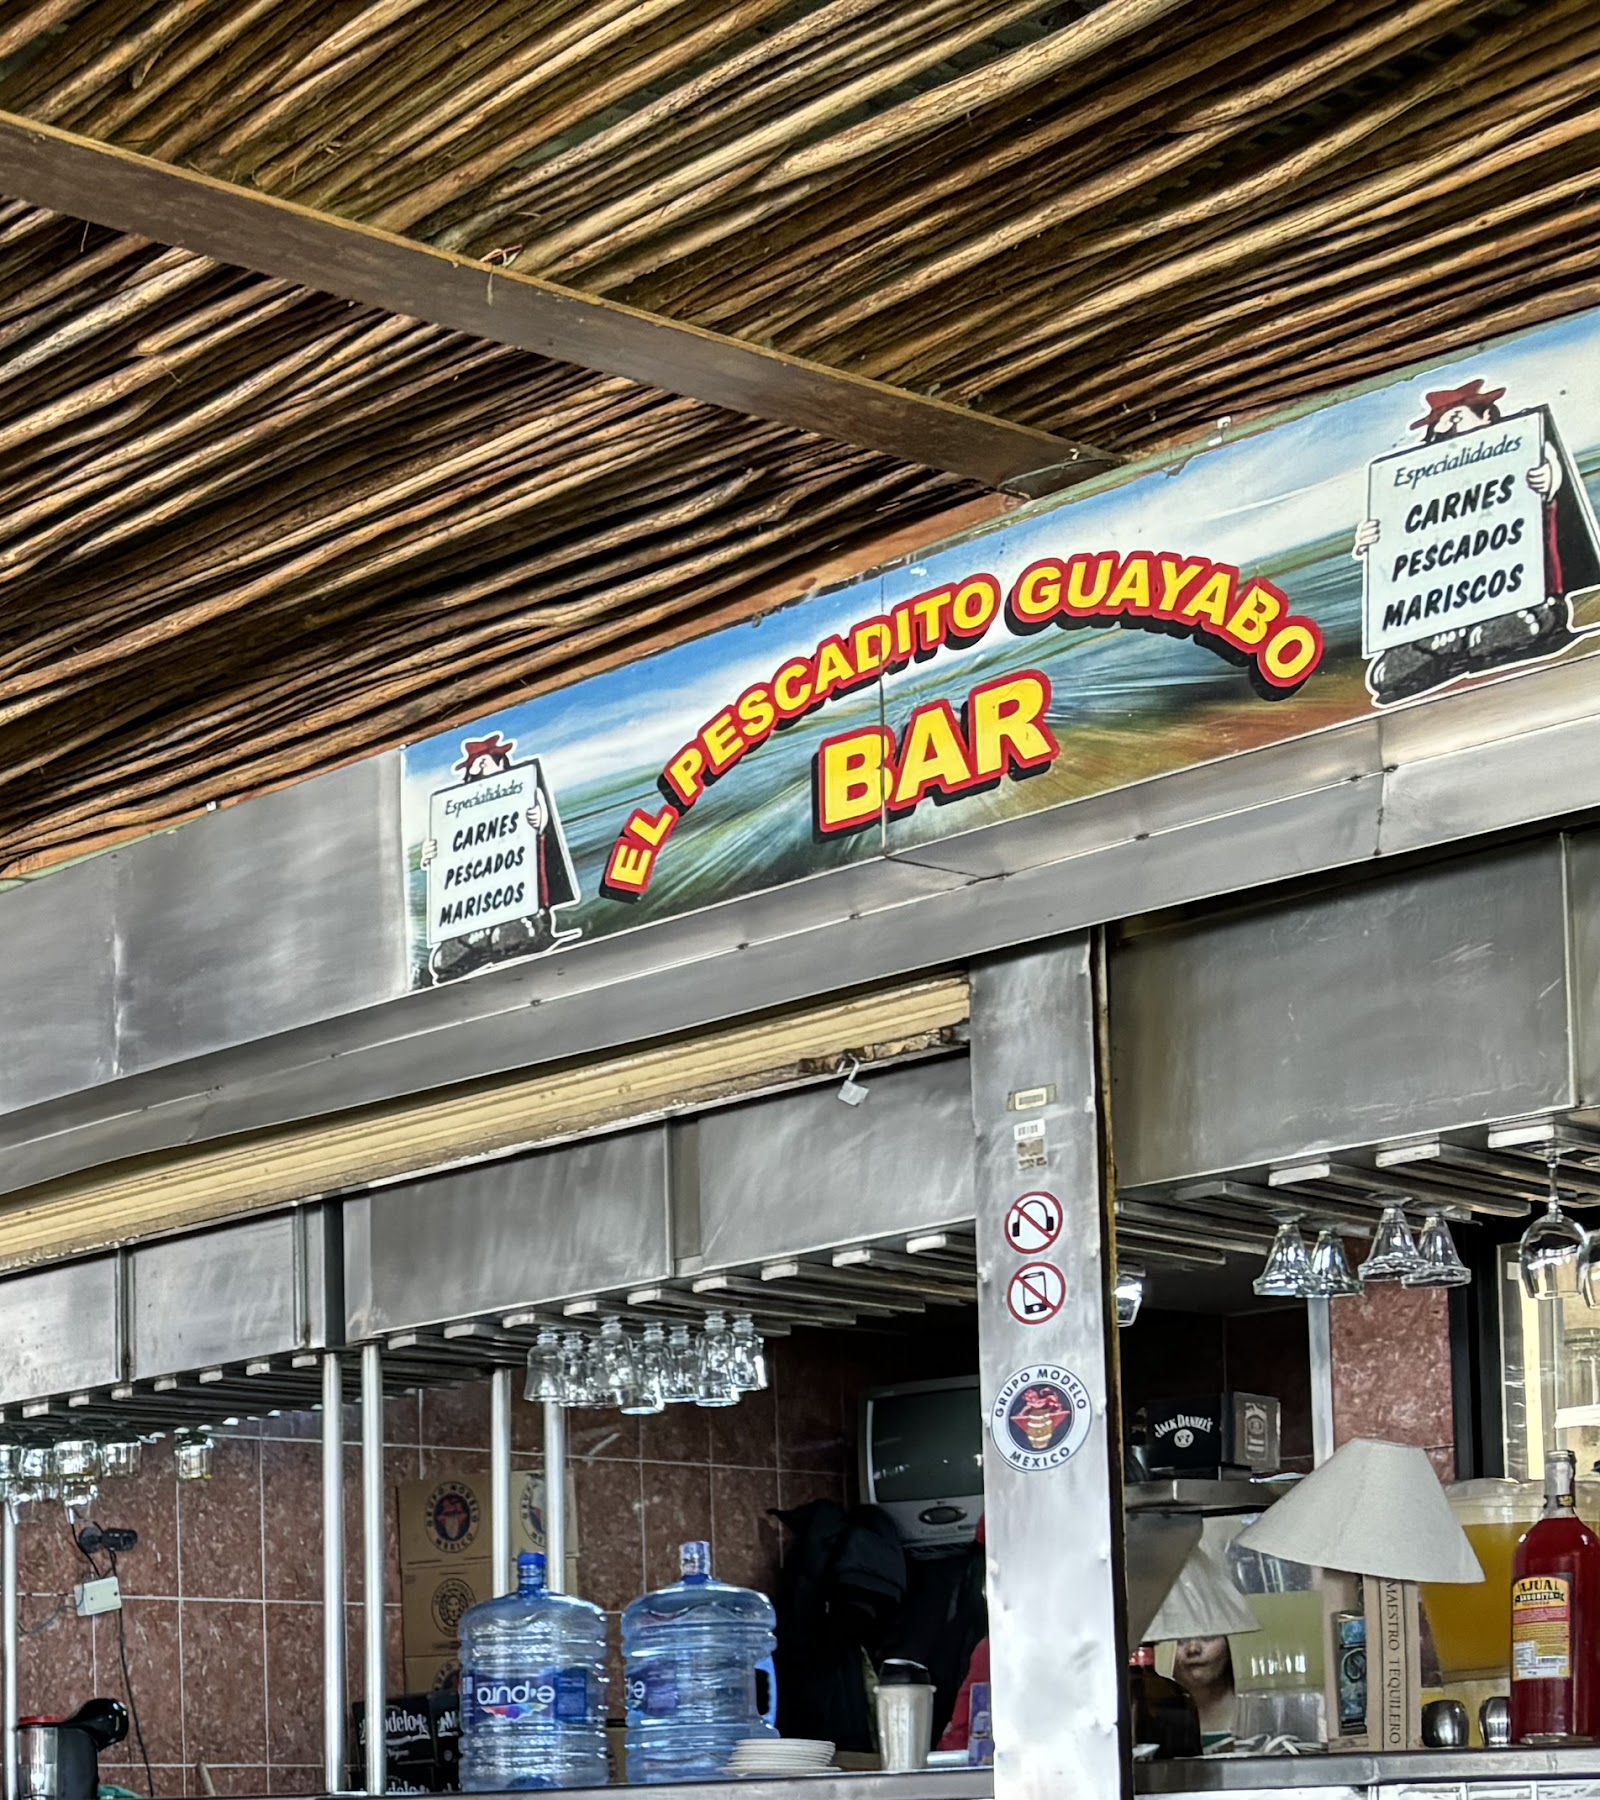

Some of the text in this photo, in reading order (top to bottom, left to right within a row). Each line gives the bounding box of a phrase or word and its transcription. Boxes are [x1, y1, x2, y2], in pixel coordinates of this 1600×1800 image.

[1393, 434, 1523, 490] Especialidades
[1404, 474, 1516, 534] CARNES
[1391, 517, 1525, 583] PESCADOS
[1381, 563, 1525, 631] MARISCOS
[607, 555, 1319, 891] EL PESCADITO GUAYABO
[822, 673, 1055, 828] BAR
[444, 780, 524, 818] Especialidades
[452, 811, 520, 853] CARNES
[444, 846, 525, 890] PESCADOS
[439, 882, 525, 927] MARISCOS
[995, 1368, 1087, 1418] GRUPO MODELO
[1009, 1446, 1070, 1468] MEXICO
[1385, 1581, 1402, 1744] MAESTRO TEQUILERO
